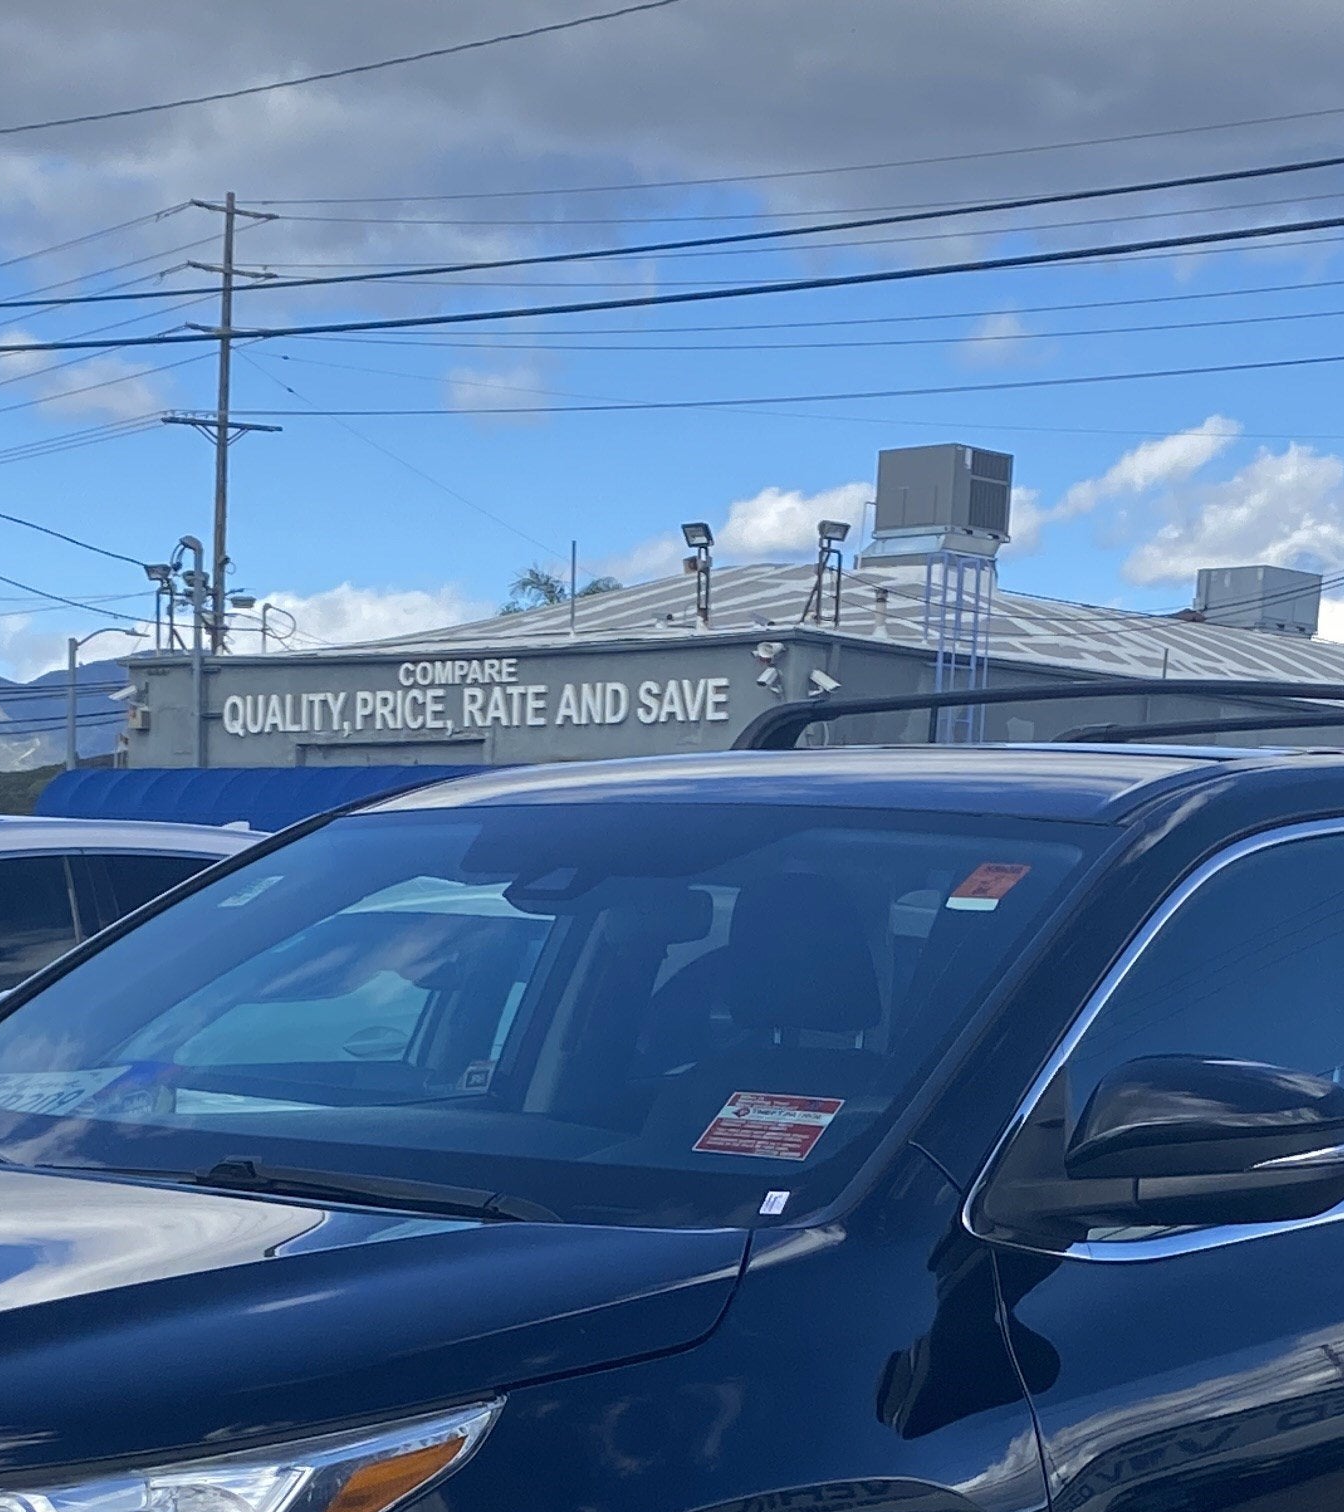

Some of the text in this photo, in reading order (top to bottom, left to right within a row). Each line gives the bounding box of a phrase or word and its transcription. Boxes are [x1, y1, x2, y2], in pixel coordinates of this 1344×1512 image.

[398, 658, 518, 687] COMPARE
[222, 677, 730, 739] QUALITY, PRICE, RATE AND SAVE
